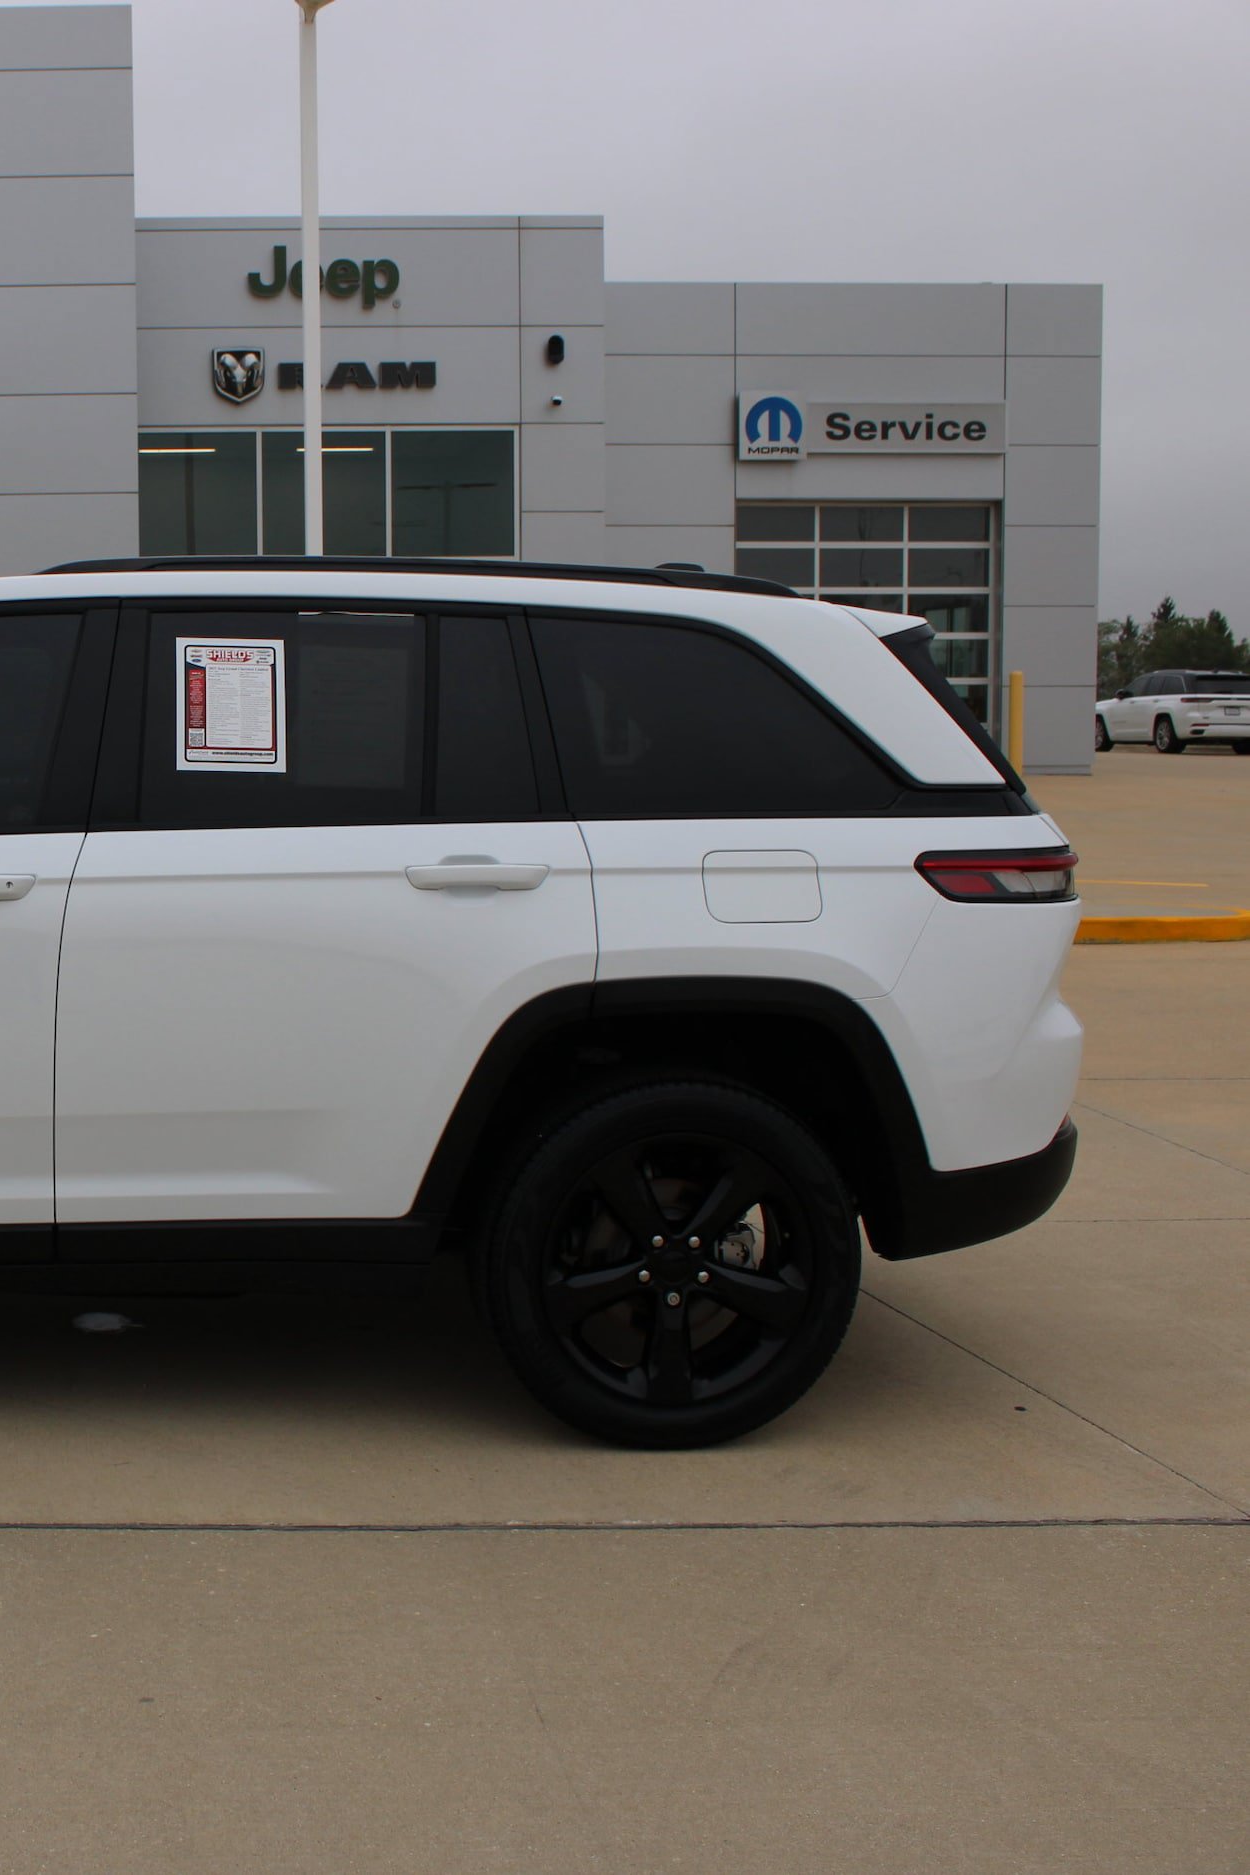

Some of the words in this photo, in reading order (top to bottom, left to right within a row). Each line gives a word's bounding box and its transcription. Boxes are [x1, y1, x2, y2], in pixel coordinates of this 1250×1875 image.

[825, 411, 987, 441] Service
[748, 446, 799, 455] MOPAR
[206, 649, 254, 659] SHIELDS
